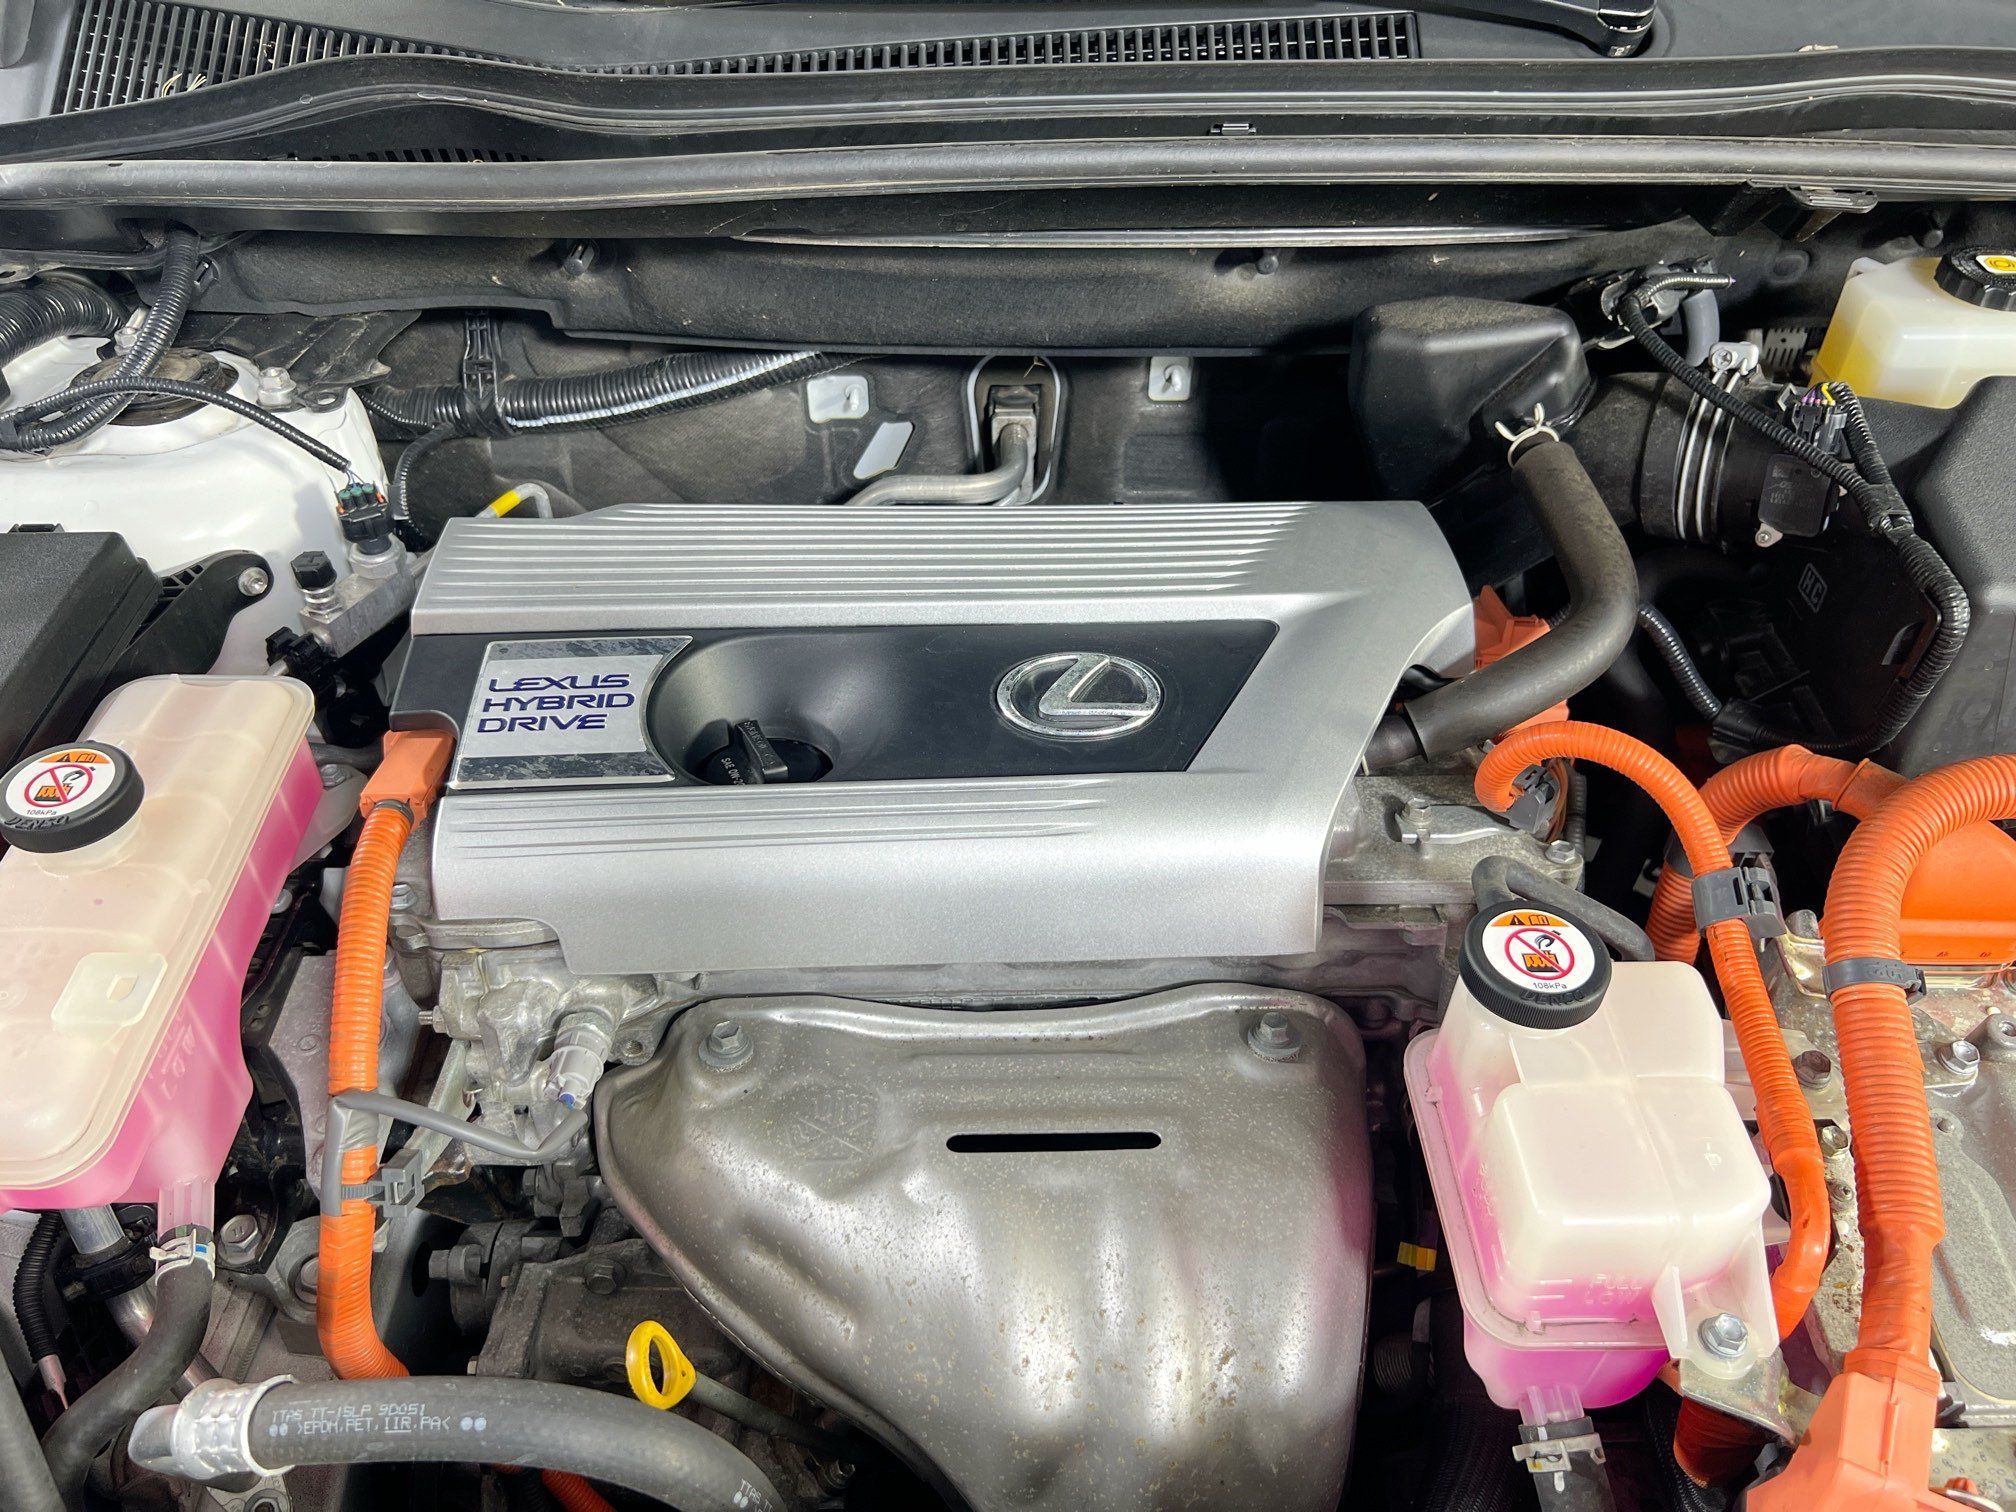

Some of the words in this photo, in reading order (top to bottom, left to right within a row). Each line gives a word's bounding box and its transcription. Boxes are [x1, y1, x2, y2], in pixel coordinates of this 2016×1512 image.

[488, 673, 630, 693] LEXUS
[482, 692, 636, 713] HYBRID
[477, 713, 609, 733] DRIVE
[26, 808, 58, 816] 108kPa
[1532, 982, 1568, 990] 108kPa
